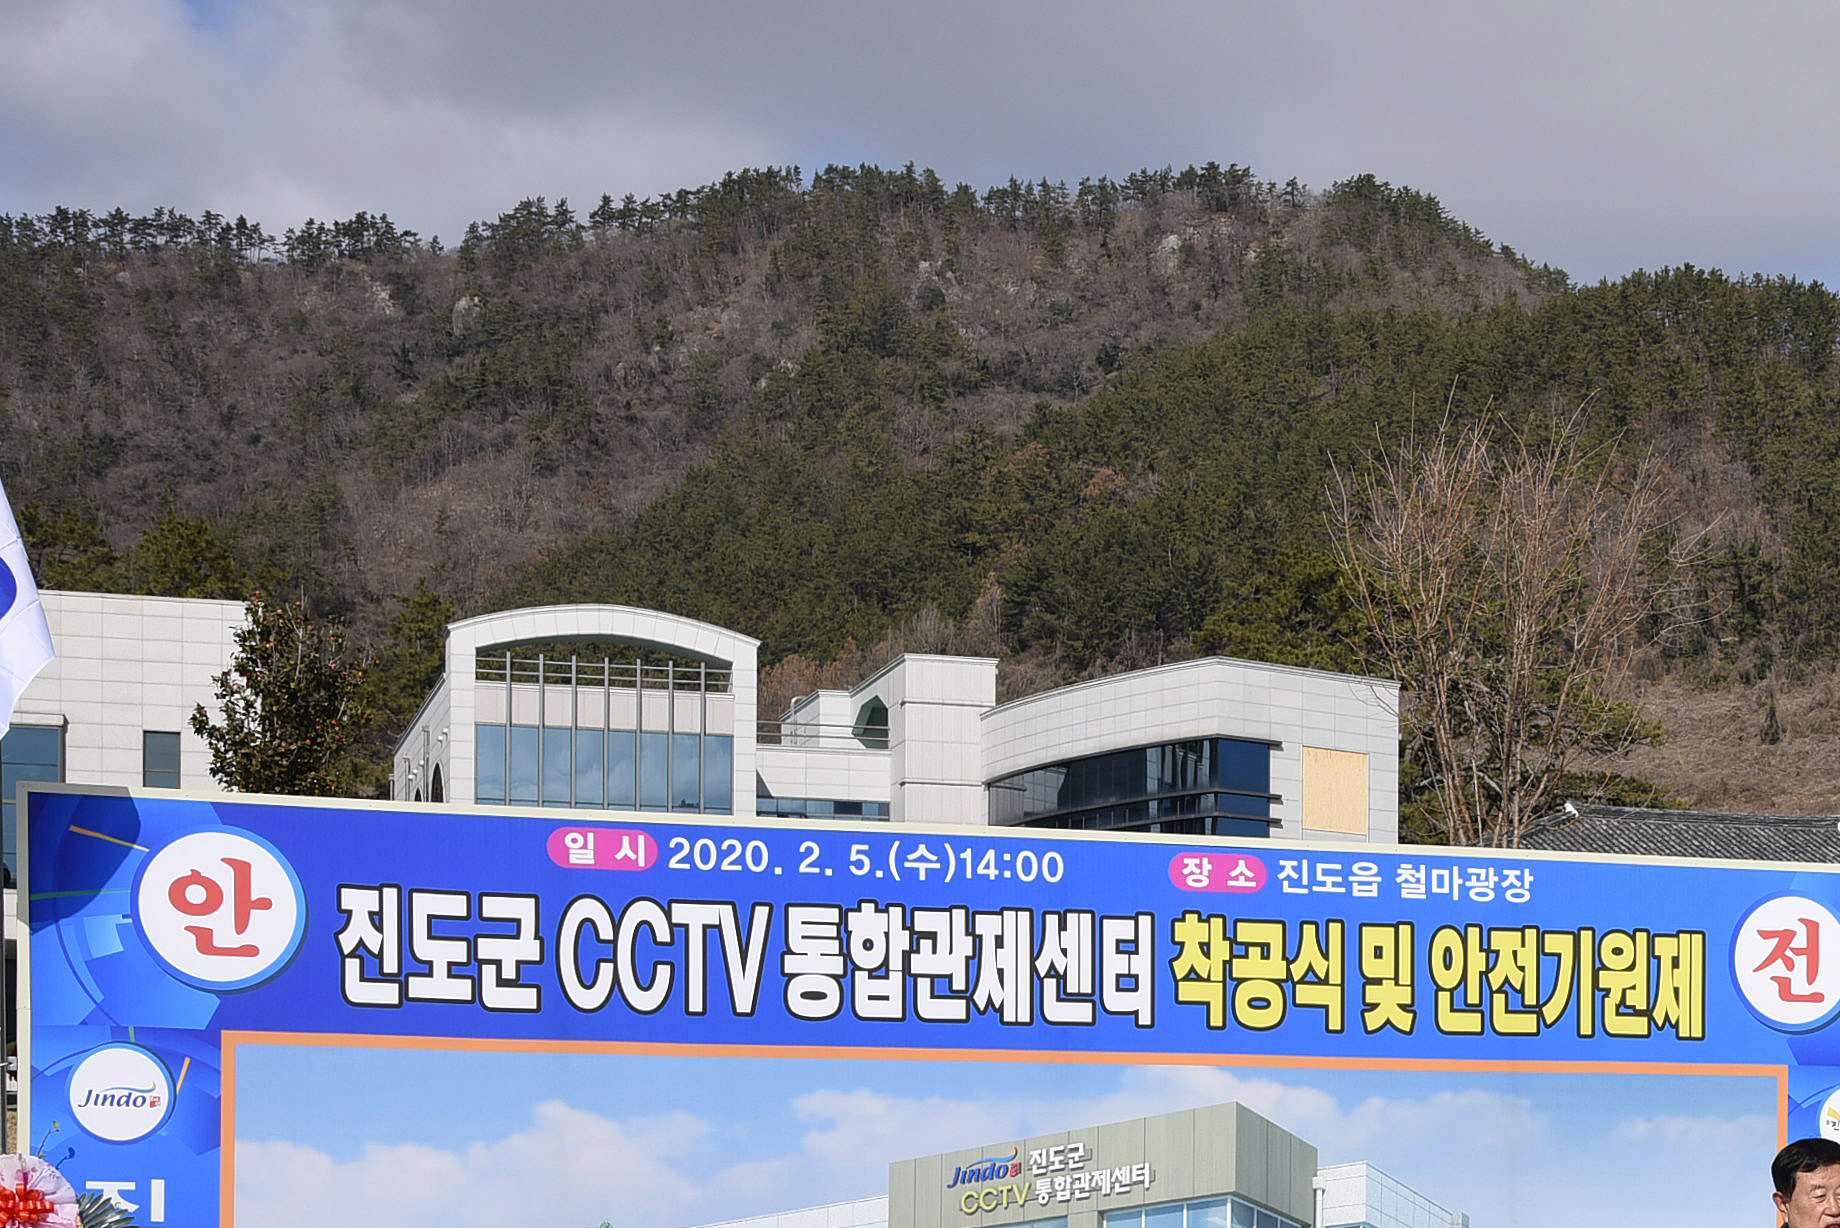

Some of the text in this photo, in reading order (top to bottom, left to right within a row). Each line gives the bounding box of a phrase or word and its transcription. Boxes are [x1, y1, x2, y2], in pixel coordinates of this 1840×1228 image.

[668, 837, 783, 876] 2020.
[799, 842, 834, 877] 2.
[1277, 859, 1382, 898] 진도읍
[1395, 864, 1534, 903] 철마광장
[168, 857, 273, 958] 안
[336, 884, 1706, 1040] 진도군 CCTV 통합관제센터 착공식 및 안전기원제
[1754, 919, 1826, 1005] 전
[78, 1089, 147, 1108] Jindo
[947, 1142, 1086, 1189] Jindo 진도군
[960, 1162, 1150, 1214] CCTV 통합관제센터
